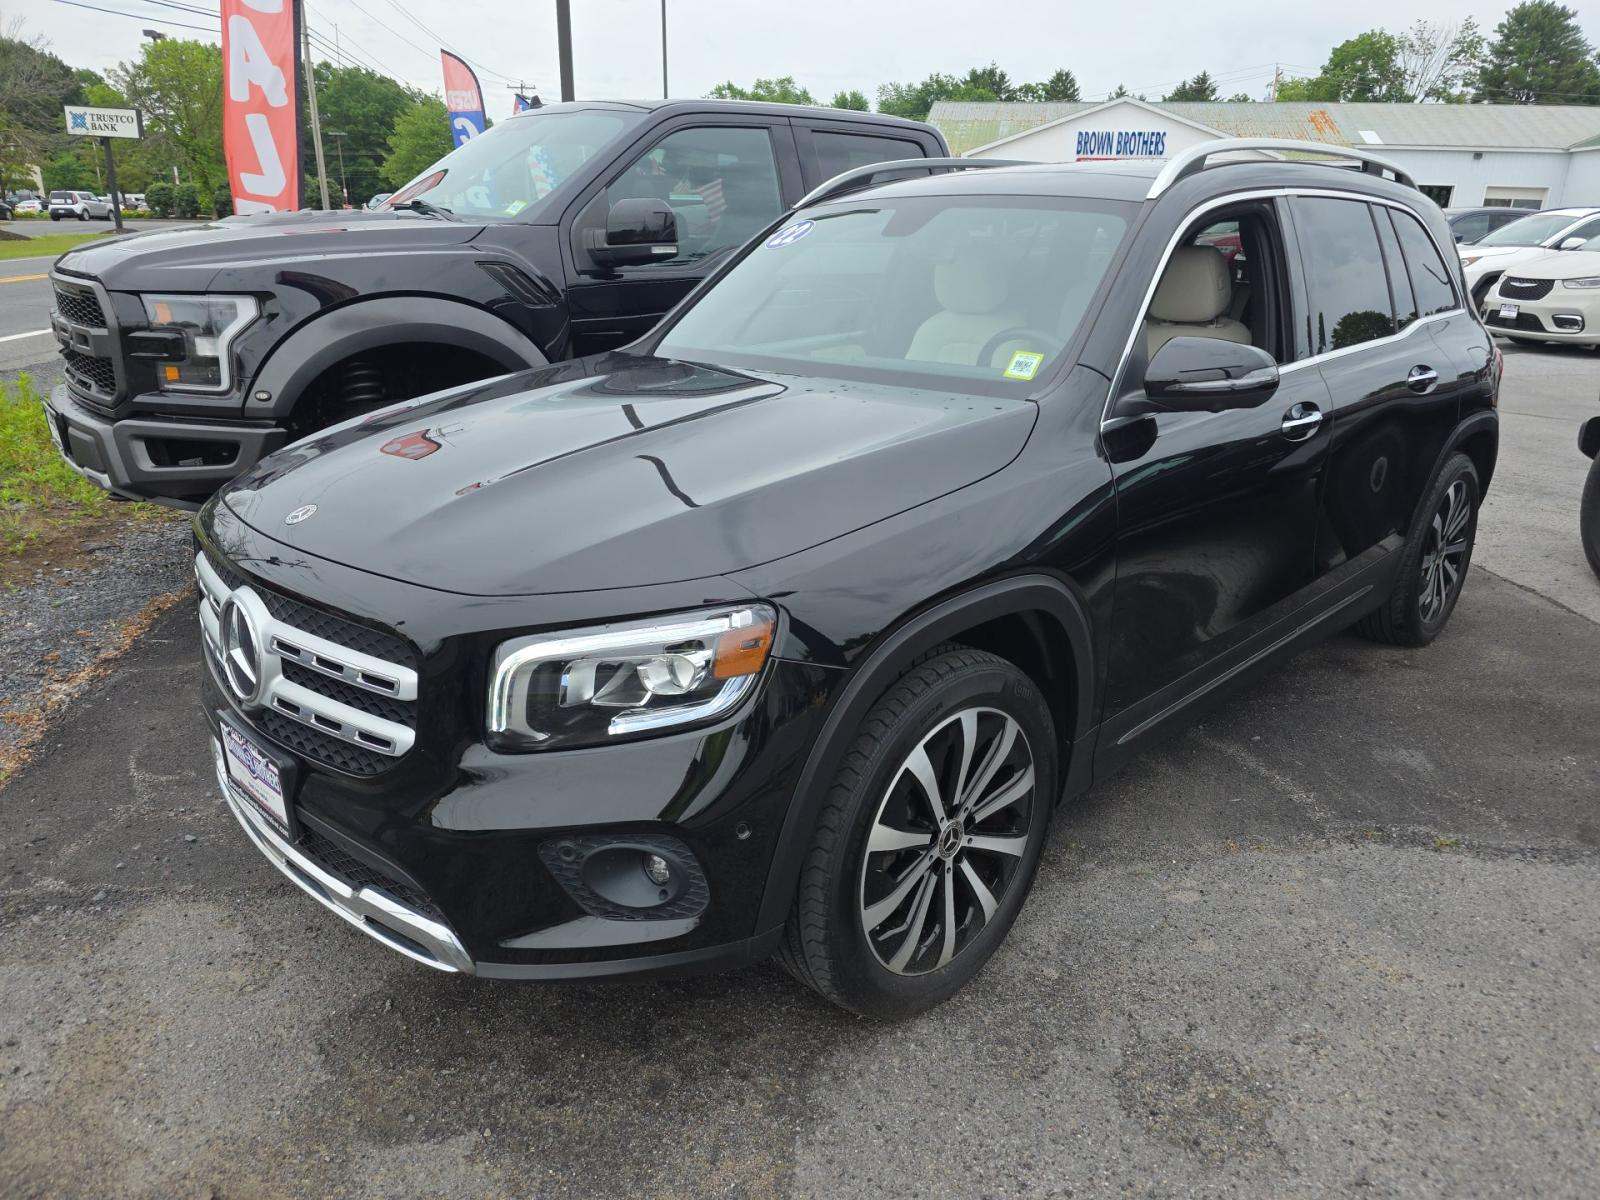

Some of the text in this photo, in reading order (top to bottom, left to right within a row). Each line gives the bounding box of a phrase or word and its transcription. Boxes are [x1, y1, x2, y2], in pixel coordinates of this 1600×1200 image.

[89, 113, 134, 124] TRUSTCO
[91, 122, 118, 132] BANK
[1076, 131, 1167, 155] BROWN BROTHERS
